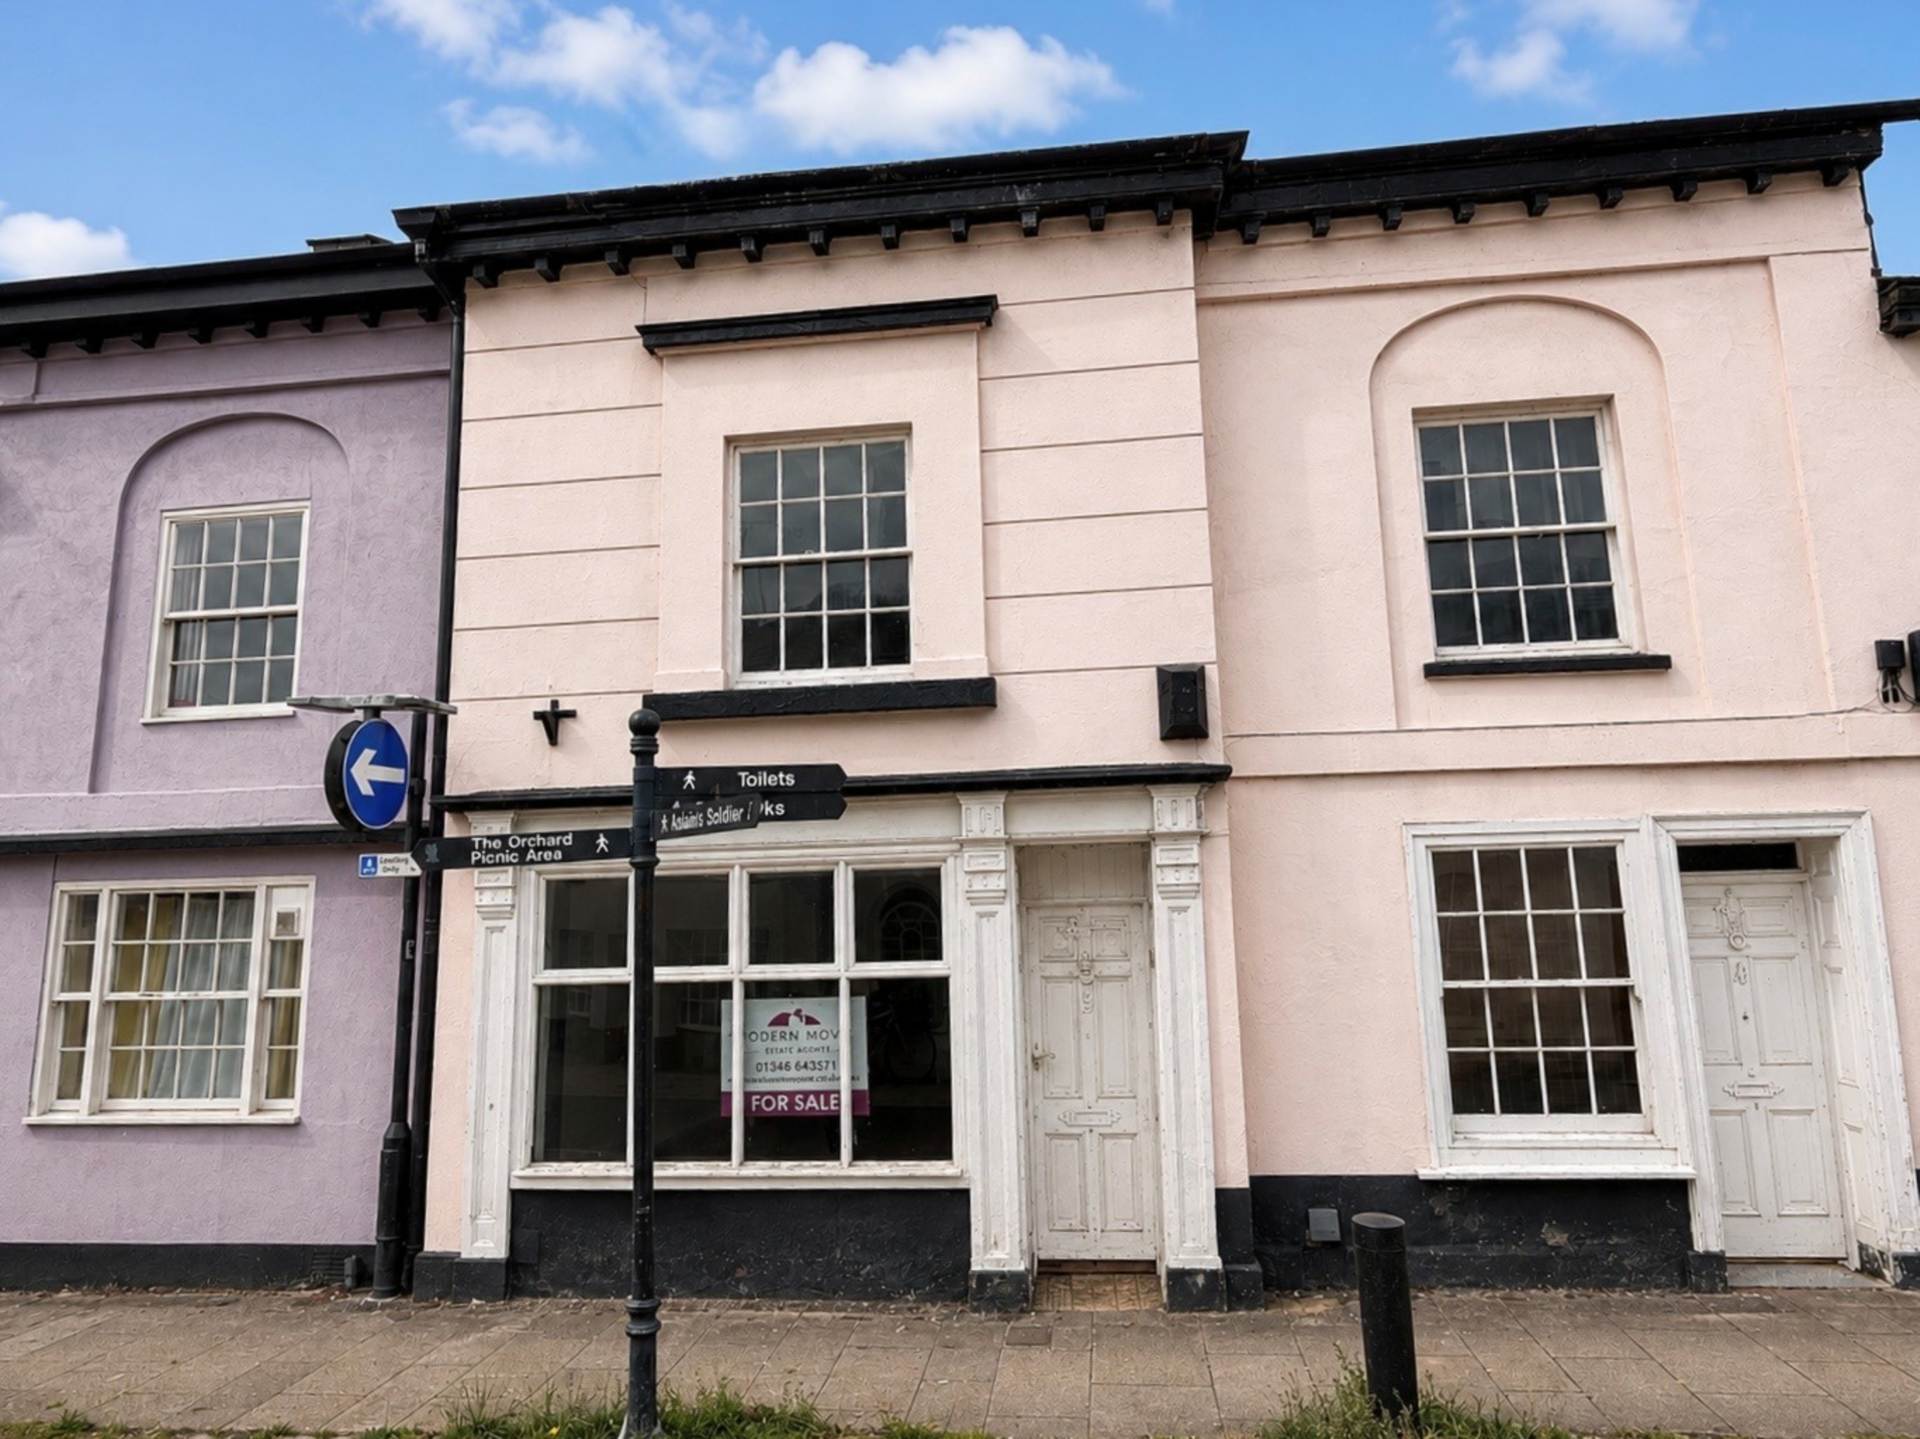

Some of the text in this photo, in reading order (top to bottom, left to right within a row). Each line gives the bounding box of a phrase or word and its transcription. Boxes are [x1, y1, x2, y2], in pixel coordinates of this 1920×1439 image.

[737, 771, 796, 788] Toilets
[706, 804, 744, 827] Soldier
[472, 832, 573, 850] The Orchard
[471, 848, 563, 865] Picnic Area
[744, 1029, 840, 1043] ODERN MOV
[751, 1094, 840, 1112] FOR SALE
